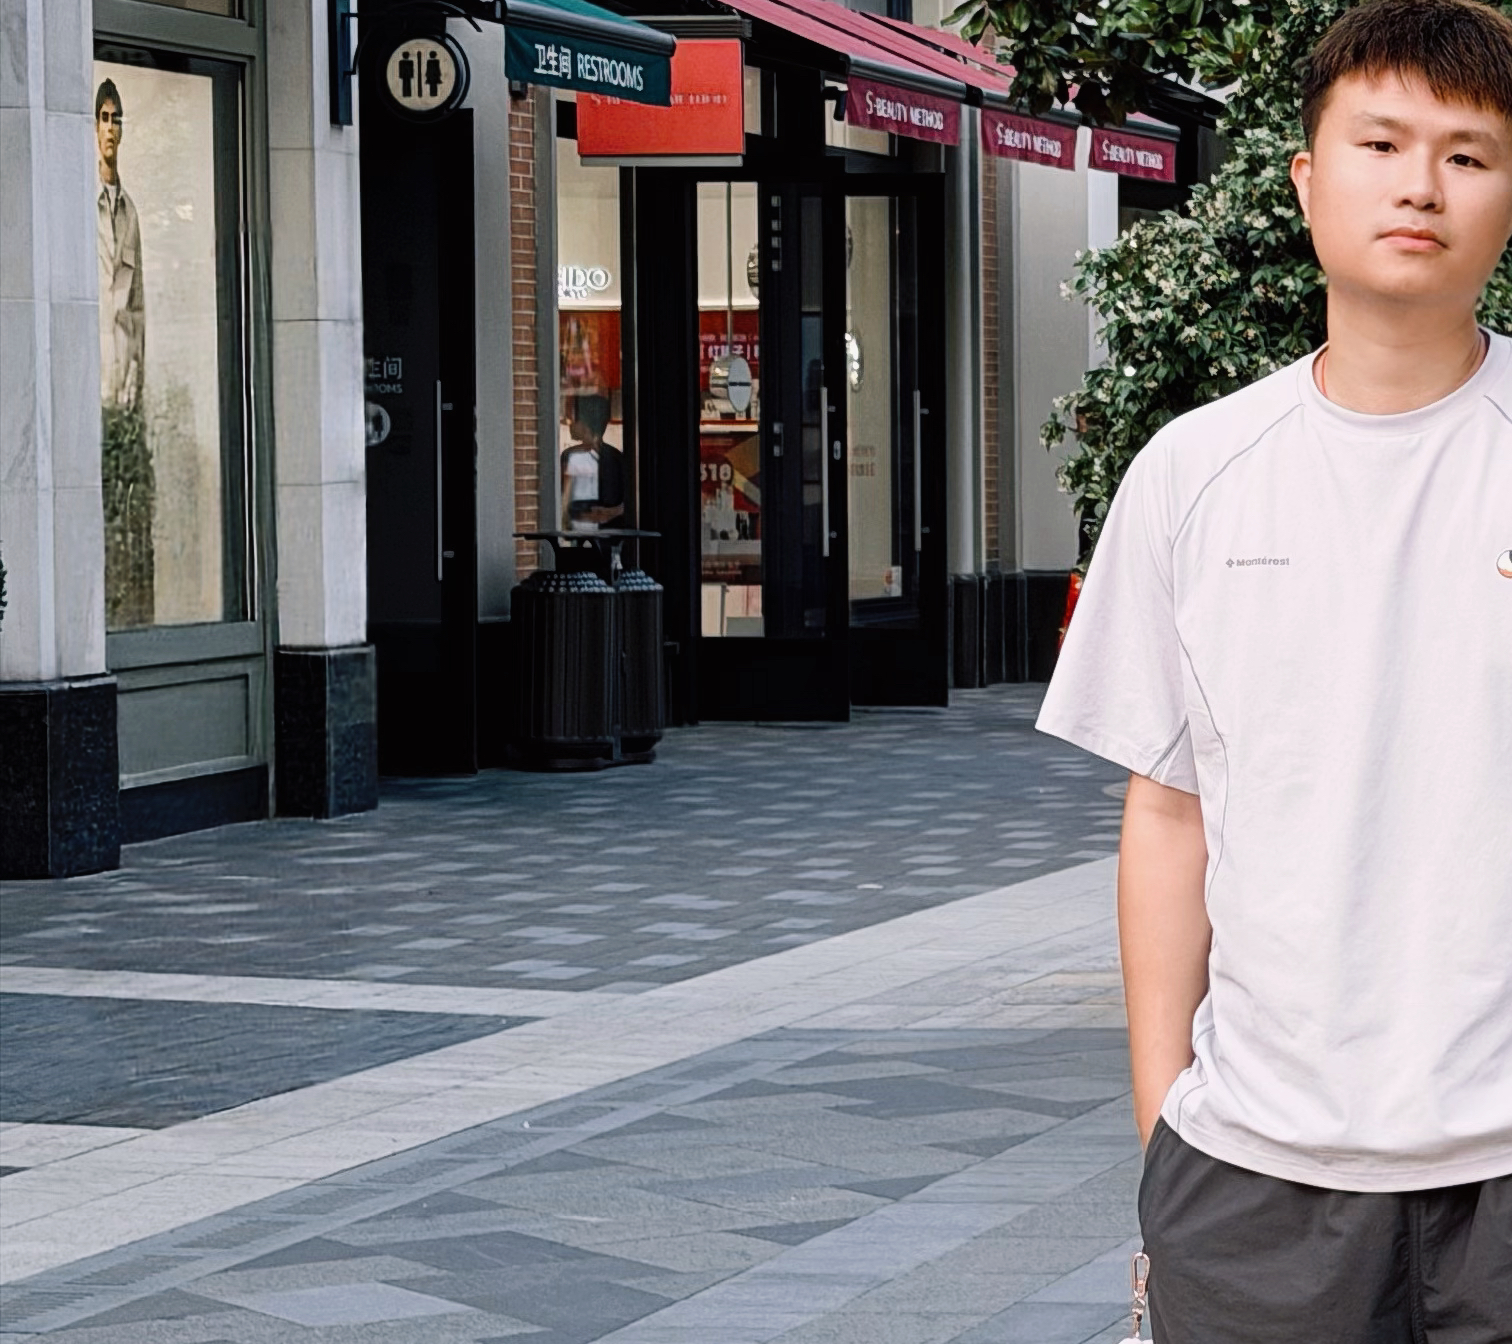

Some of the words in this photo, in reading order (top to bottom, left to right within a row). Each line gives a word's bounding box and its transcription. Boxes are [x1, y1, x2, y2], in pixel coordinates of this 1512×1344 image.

[534, 43, 572, 80] 卫生间
[577, 52, 644, 92] RESTROOMS
